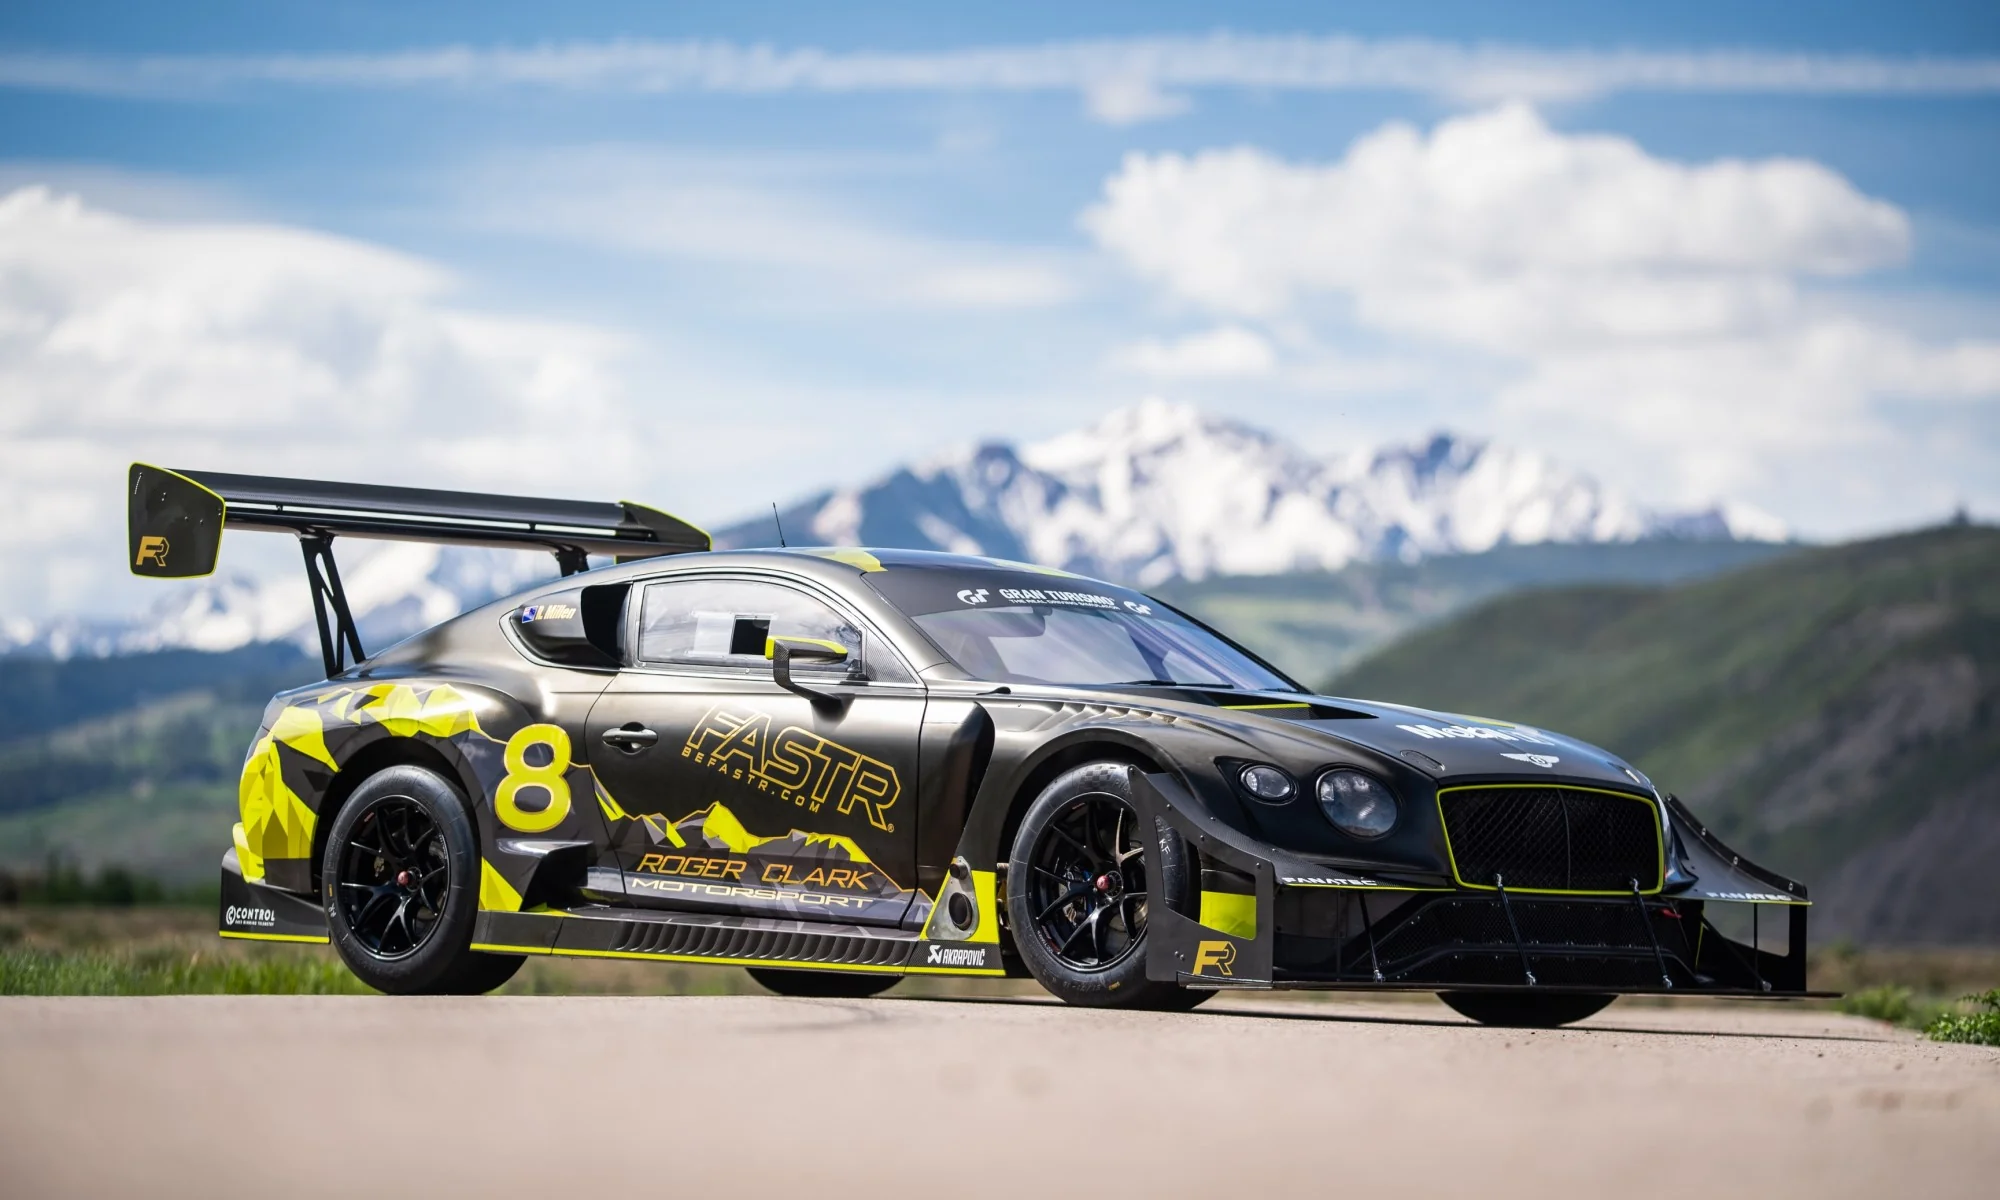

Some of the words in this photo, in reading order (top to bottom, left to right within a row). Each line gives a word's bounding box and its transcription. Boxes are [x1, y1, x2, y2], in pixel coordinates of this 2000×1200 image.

[998, 588, 1047, 600] GRAN
[1044, 590, 1115, 606] TURISMO
[544, 604, 577, 620] Millen
[494, 723, 572, 833] 8
[681, 745, 821, 813] BEFASTR.COM
[687, 703, 901, 831] FASTR
[636, 853, 747, 880] ROGER
[761, 863, 874, 890] CLARK
[1281, 877, 1378, 886] FANATEC
[632, 878, 874, 909] MOTORSPORT
[1705, 892, 1793, 902] FANATEC
[236, 907, 275, 922] CONTROL
